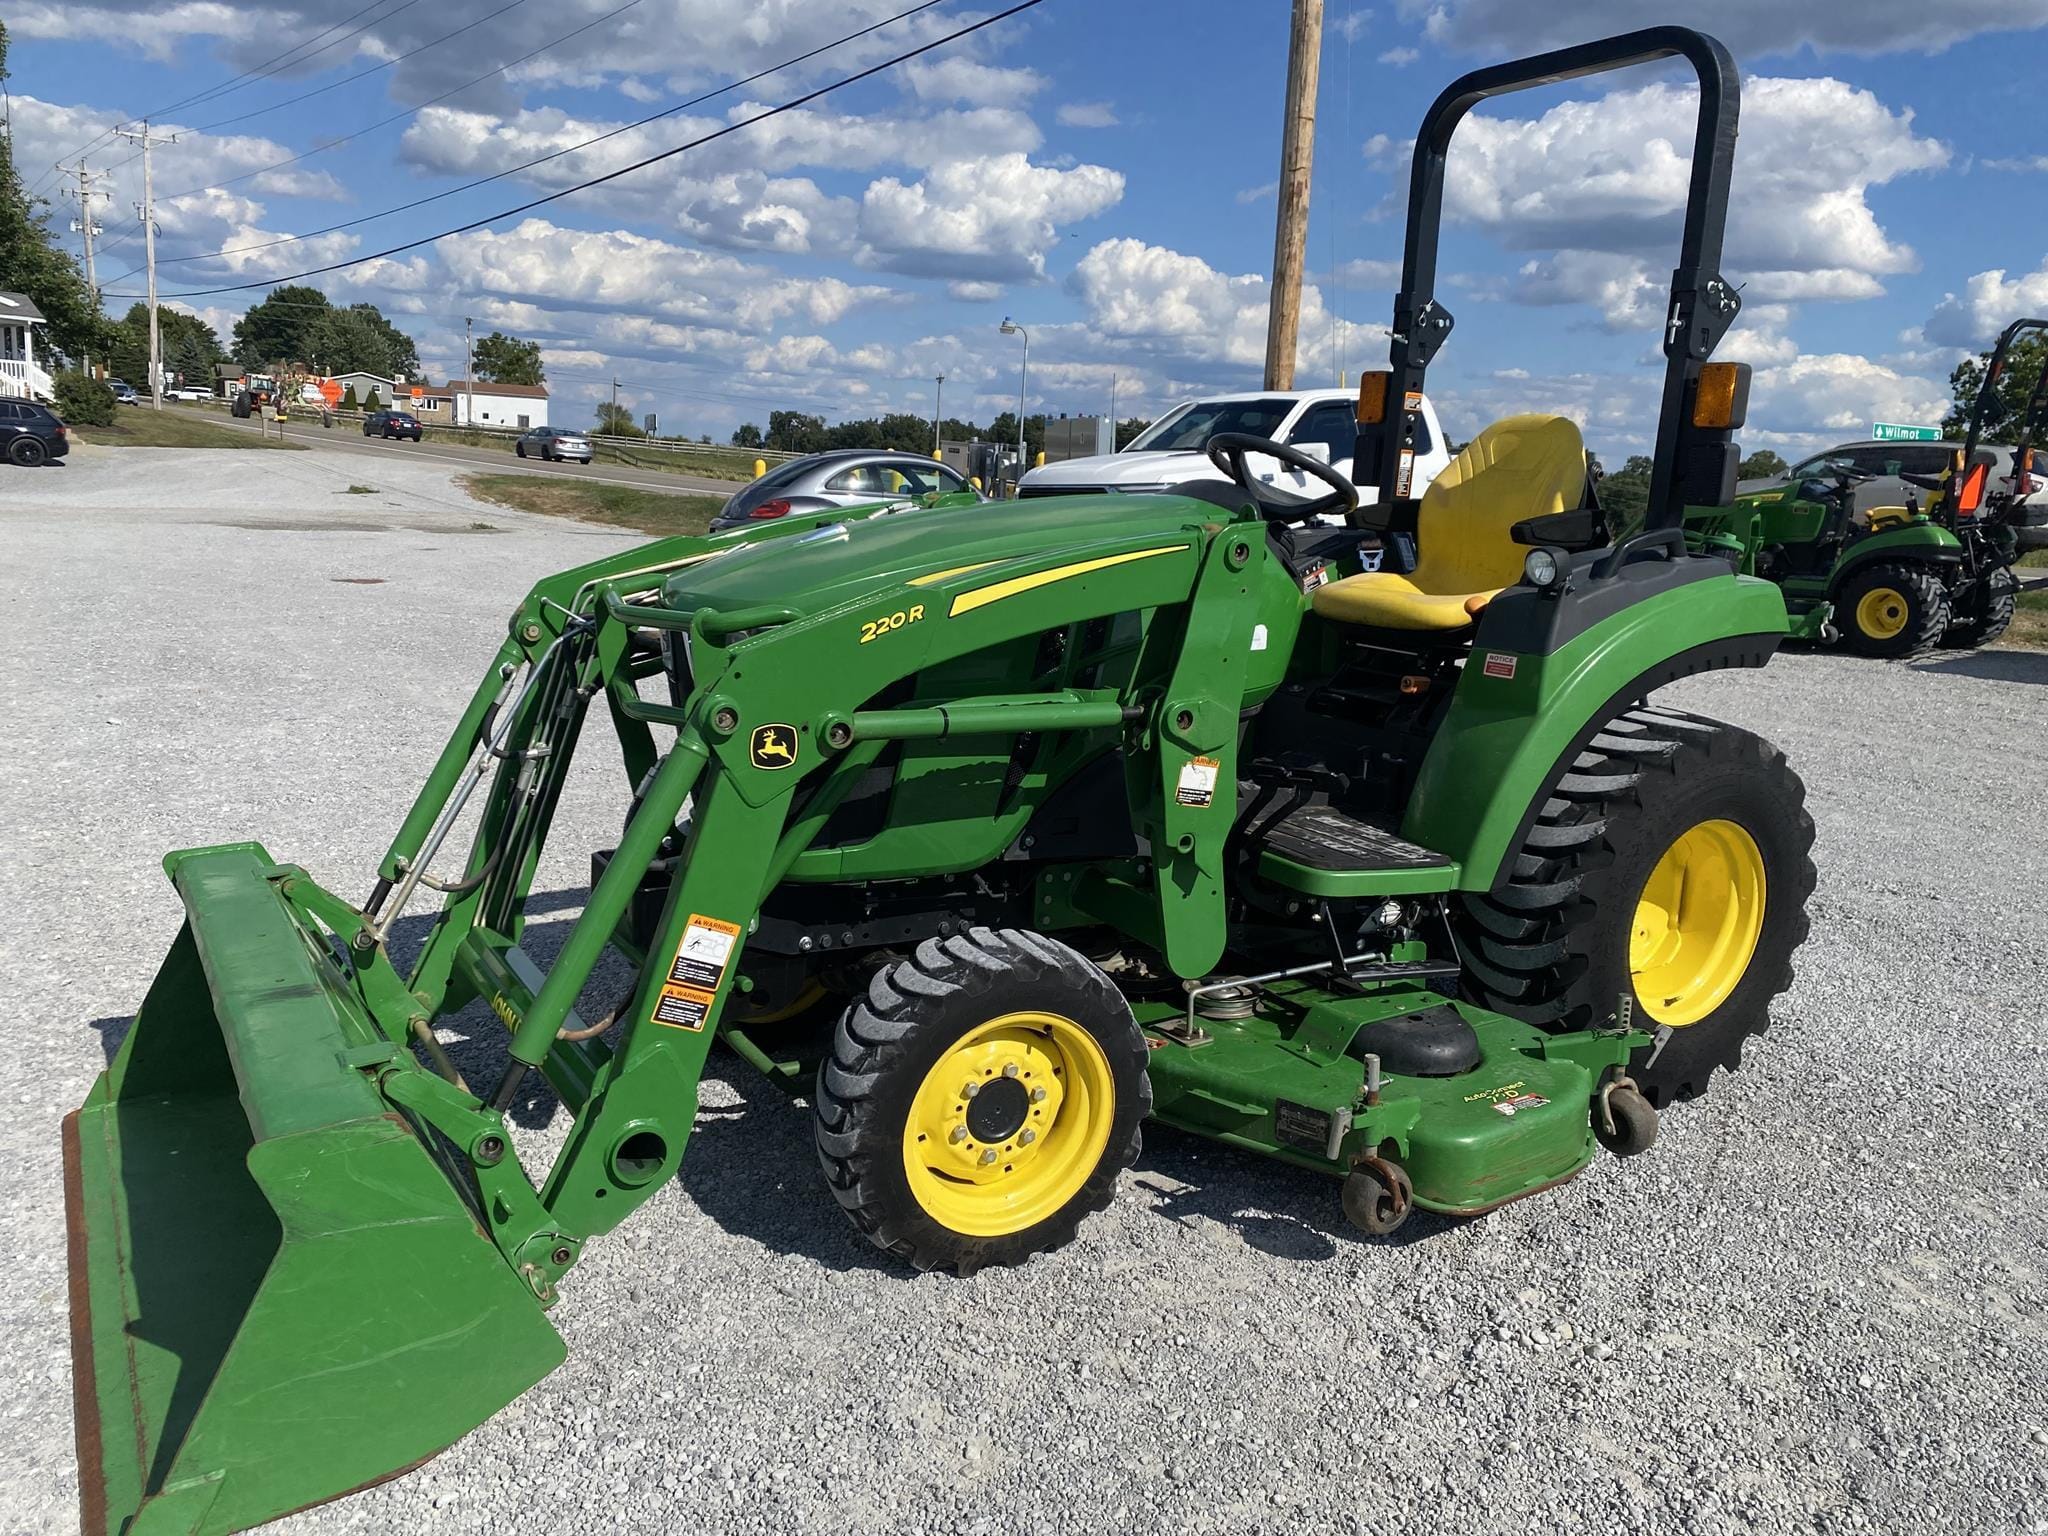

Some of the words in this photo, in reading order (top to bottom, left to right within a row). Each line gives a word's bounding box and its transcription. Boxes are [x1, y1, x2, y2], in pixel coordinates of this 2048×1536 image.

[1885, 426, 1920, 440] Wilmot
[1933, 431, 1941, 441] 5
[1489, 654, 1515, 664] NOTICE
[703, 920, 734, 934] WARNING
[676, 990, 708, 1003] WARNING
